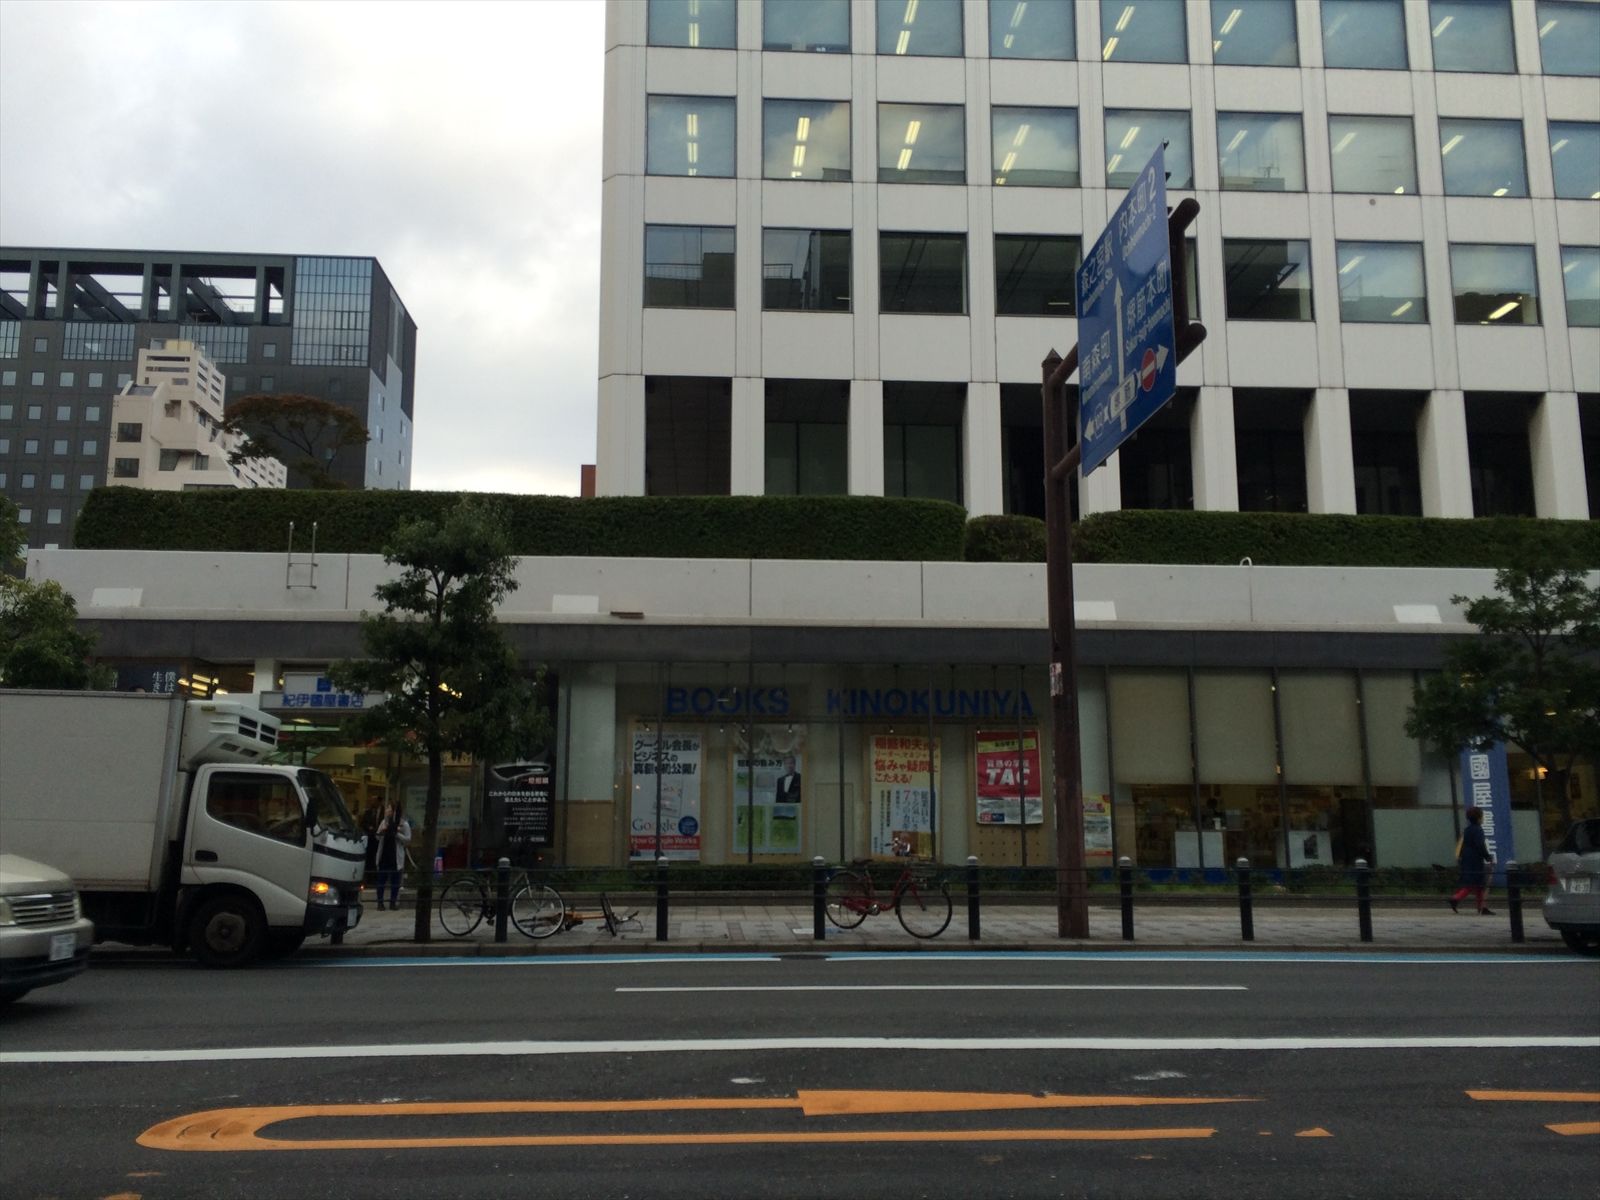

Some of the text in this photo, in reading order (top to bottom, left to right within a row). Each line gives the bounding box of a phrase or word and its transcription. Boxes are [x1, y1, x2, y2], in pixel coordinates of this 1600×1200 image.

[666, 687, 1033, 717] BOOKS KINOKUNIYA
[986, 769, 1030, 786] TAC
[632, 819, 677, 832] Google
